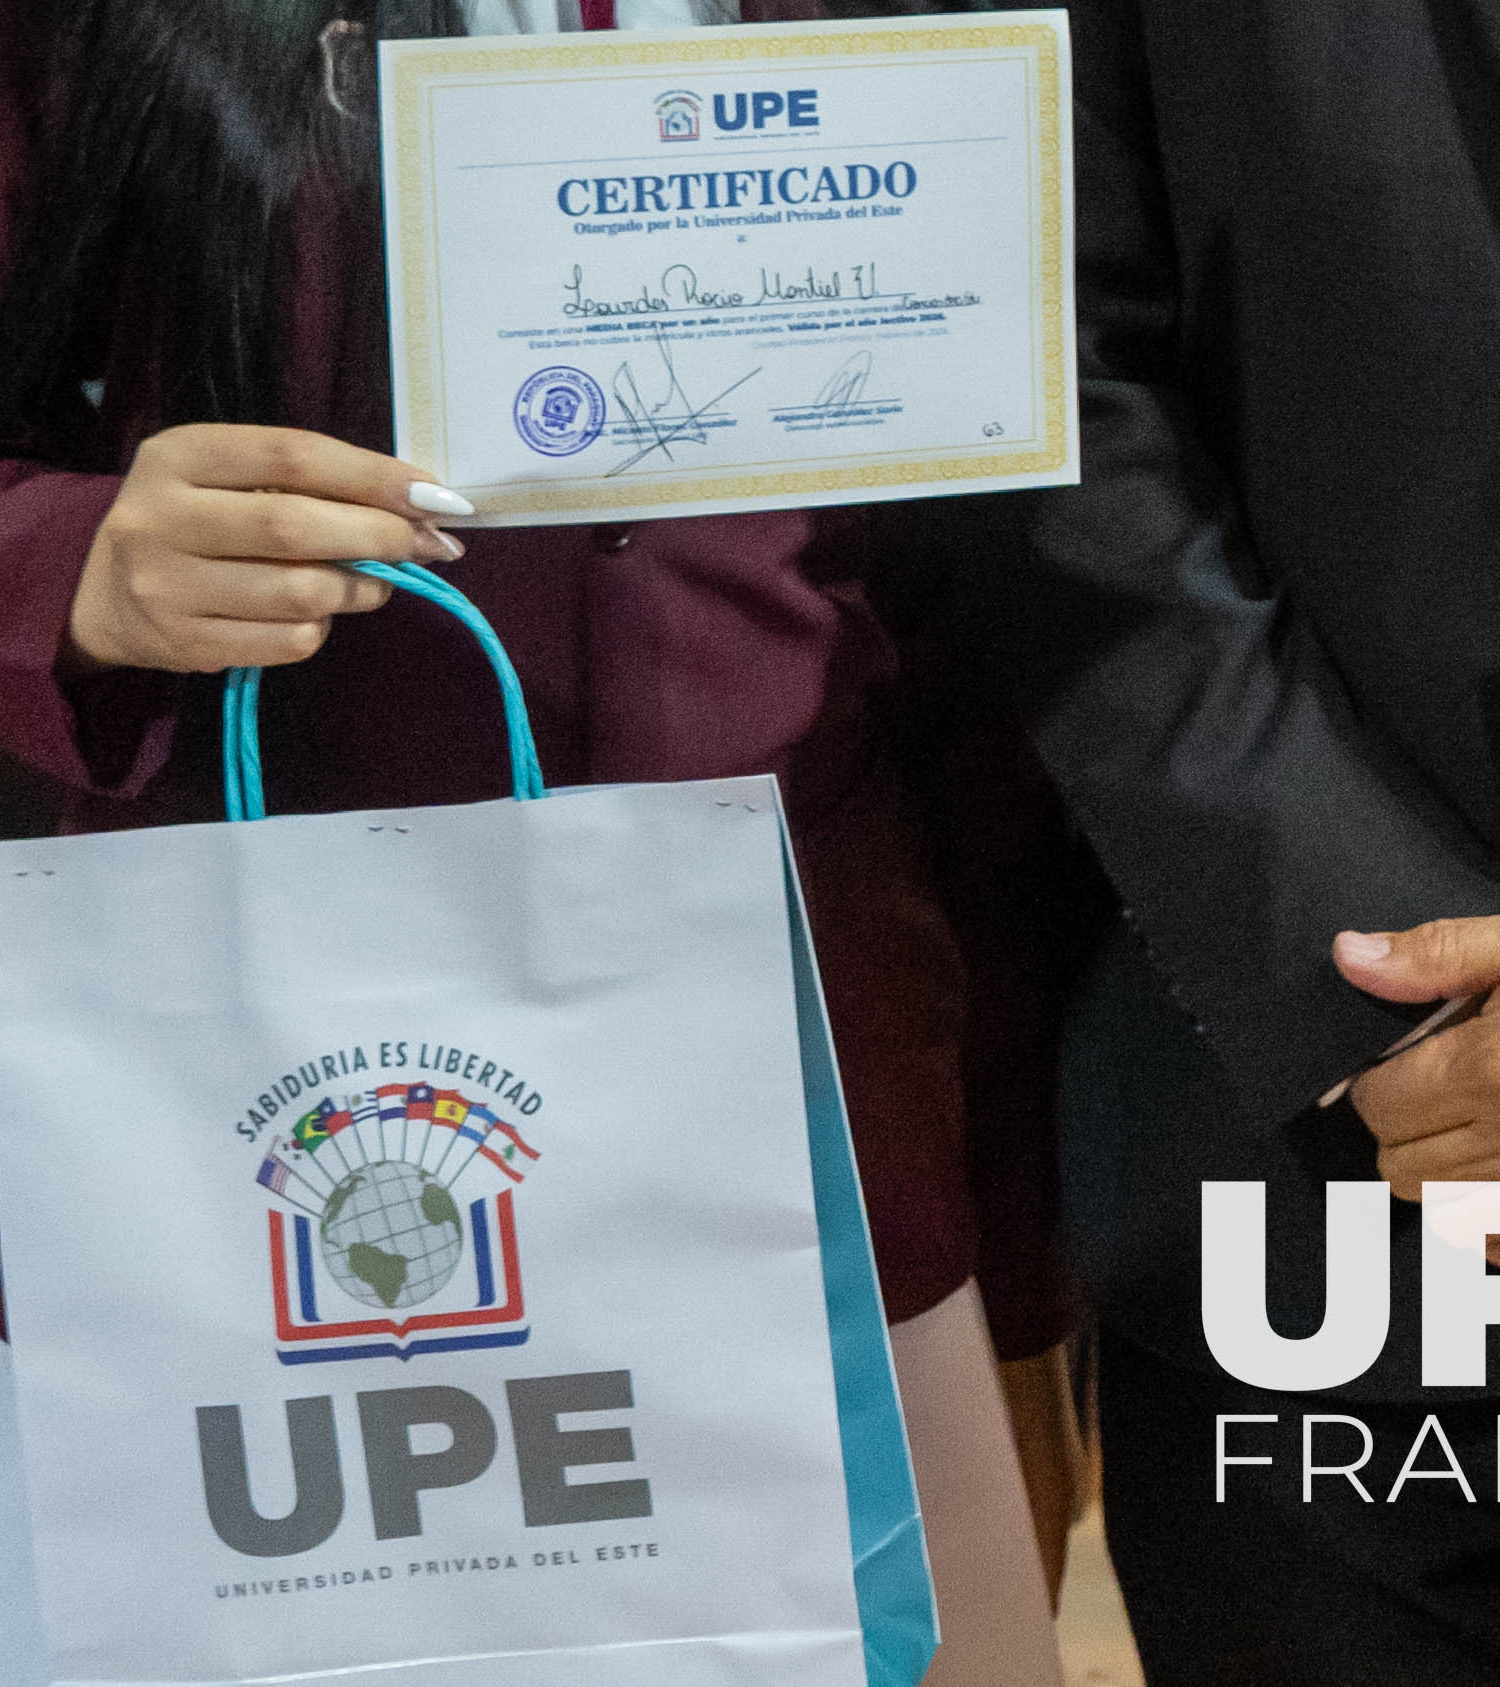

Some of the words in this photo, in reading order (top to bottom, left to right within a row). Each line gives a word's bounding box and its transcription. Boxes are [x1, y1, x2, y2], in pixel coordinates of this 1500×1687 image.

[713, 89, 819, 131] UPE
[555, 159, 917, 218] CERTIFICADO
[573, 218, 642, 237] Otorgado
[647, 217, 670, 232] por
[675, 216, 689, 229] la
[693, 210, 780, 228] Universidad
[786, 206, 841, 222] Privada
[845, 205, 867, 218] del
[871, 203, 903, 217] Este
[982, 421, 1005, 437] 63
[236, 1046, 368, 1142] SABIDURIA
[380, 1042, 408, 1067] ES
[419, 1043, 543, 1115] LIBERTAD
[195, 1369, 653, 1558] UPE
[215, 1566, 392, 1599] UNIVERSIDAD
[408, 1556, 518, 1578] PRIVADA
[533, 1550, 579, 1566] DEL
[596, 1543, 661, 1561] ESTE
